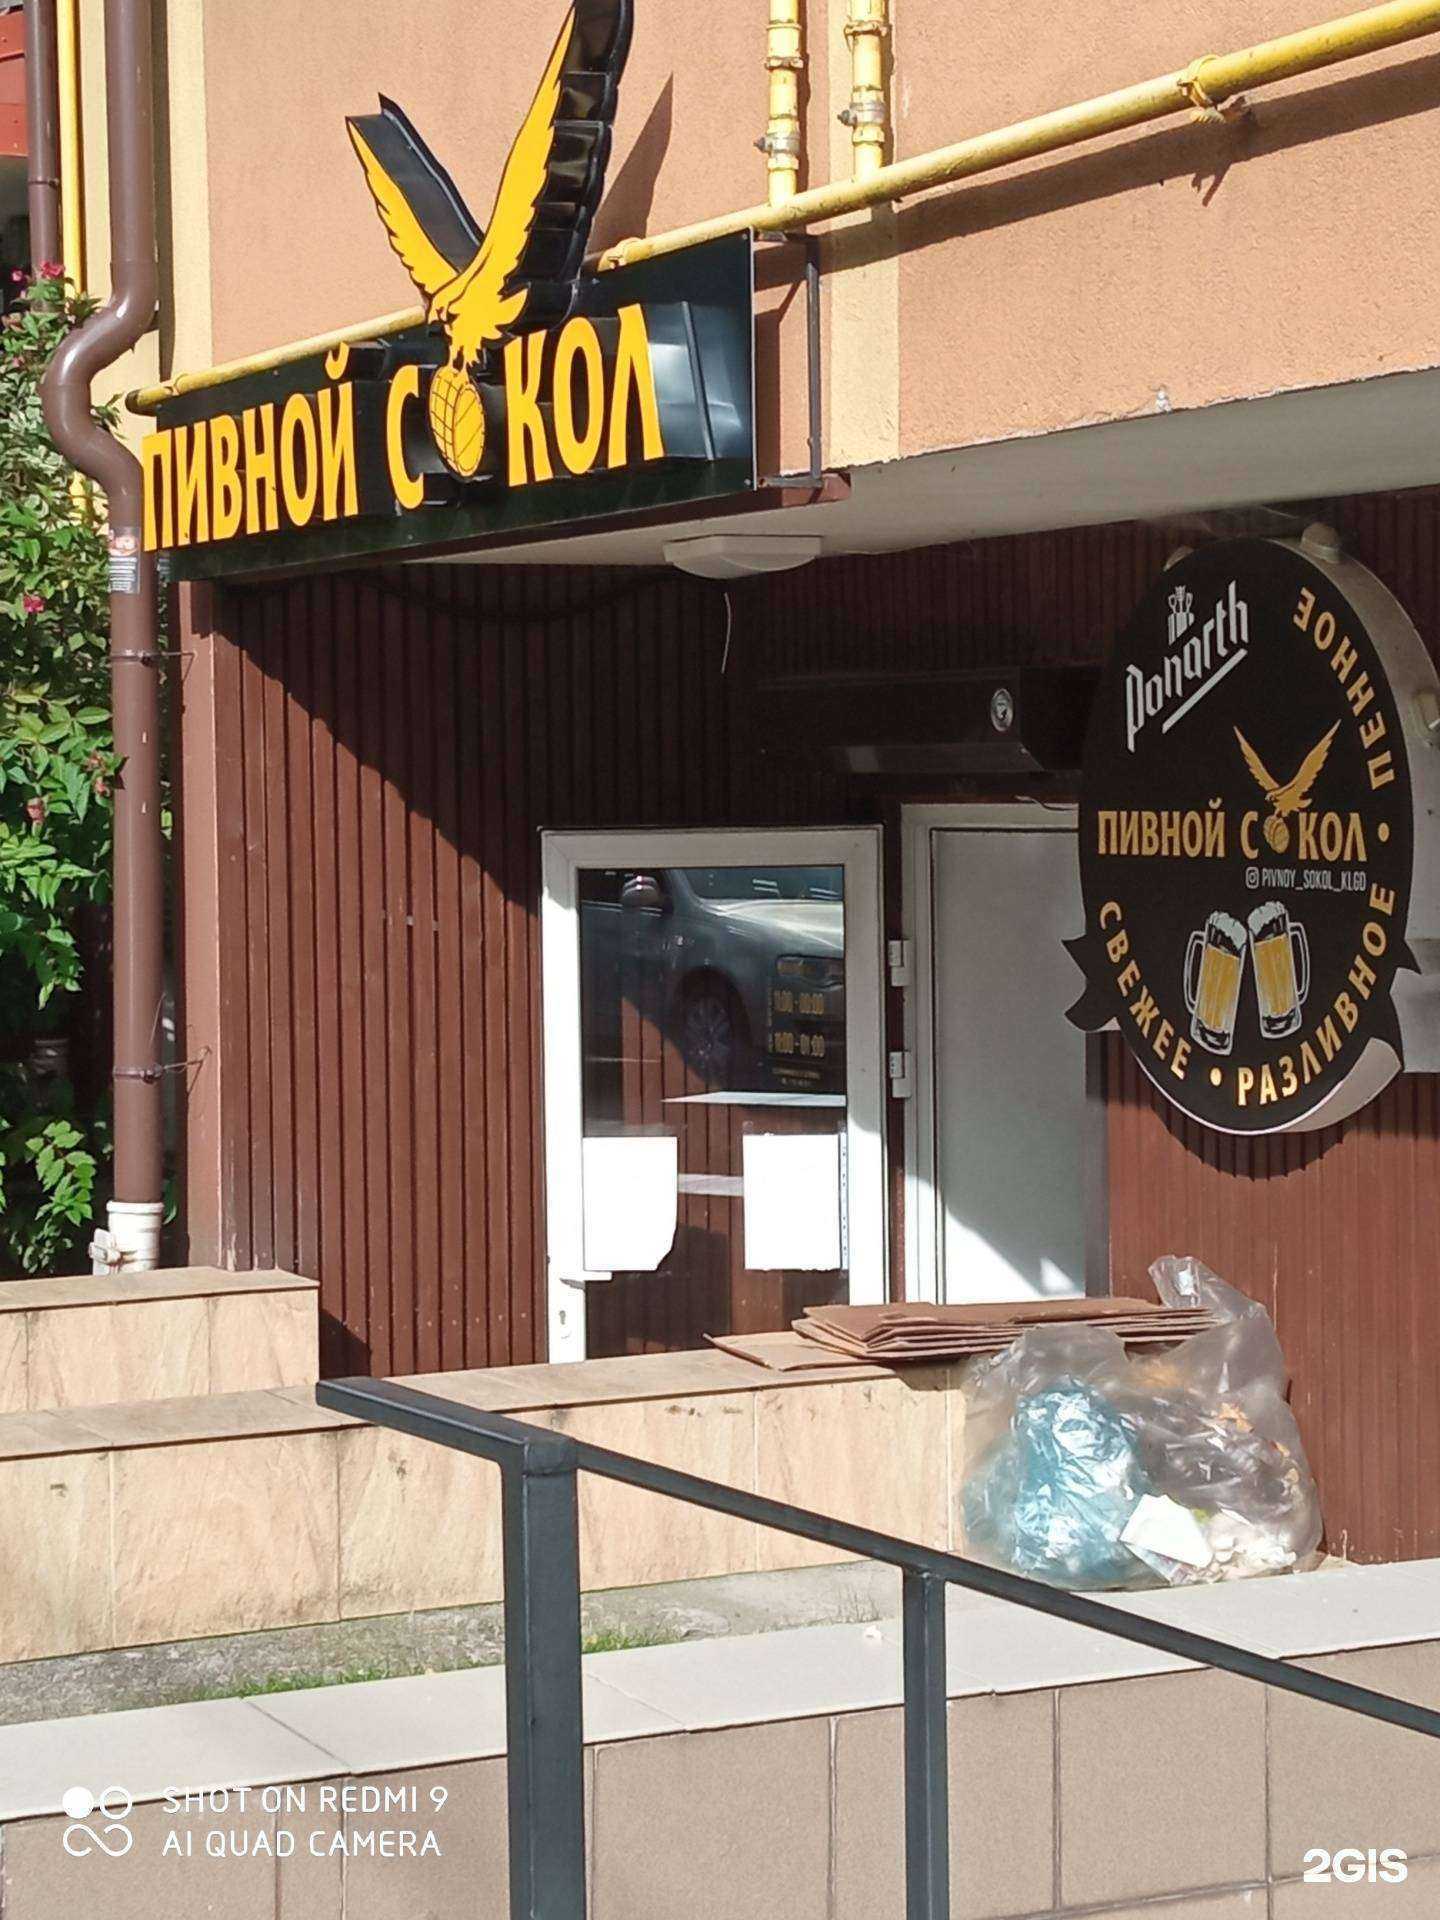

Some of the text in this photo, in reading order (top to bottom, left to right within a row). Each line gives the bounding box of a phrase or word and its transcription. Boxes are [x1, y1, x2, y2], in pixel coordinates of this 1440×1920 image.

[143, 342, 358, 552] ПИВНОЙ
[1125, 580, 1249, 753] Ponarth
[1293, 587, 1395, 790] ПЕННОЕ
[1098, 797, 1225, 858] ПИВНОЙ
[1100, 901, 1191, 1080] СВЕЖЕЕ
[1238, 883, 1395, 1106] РАЗЛИВНОЕ
